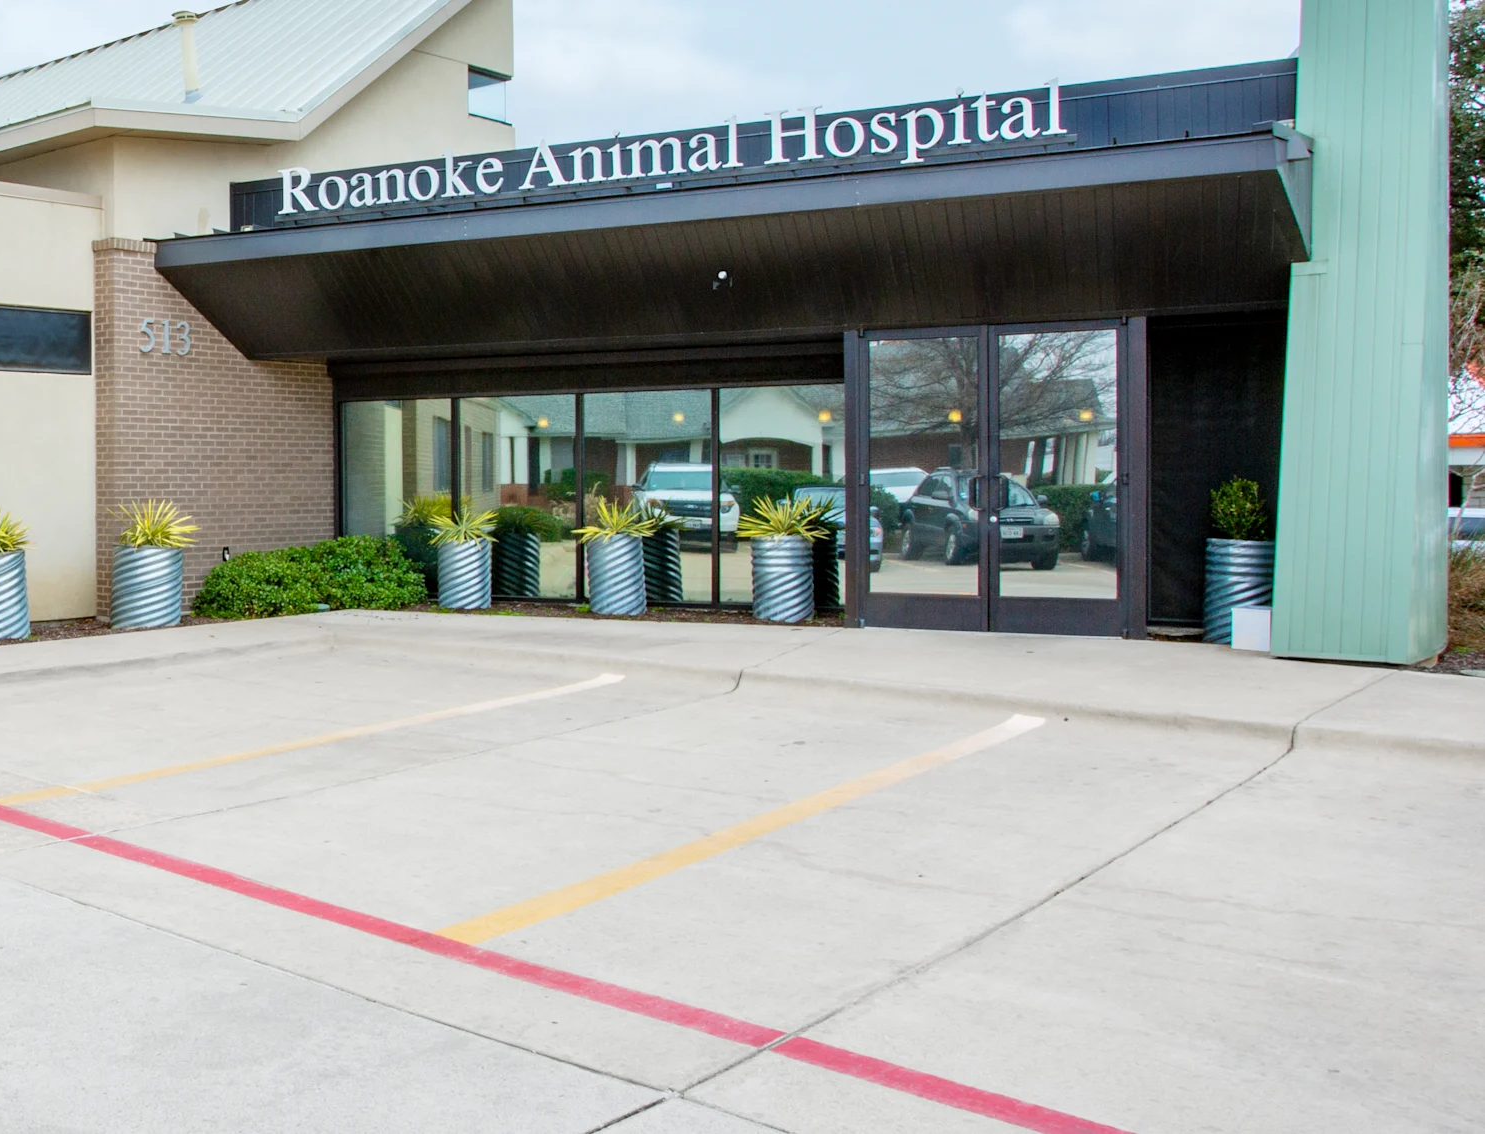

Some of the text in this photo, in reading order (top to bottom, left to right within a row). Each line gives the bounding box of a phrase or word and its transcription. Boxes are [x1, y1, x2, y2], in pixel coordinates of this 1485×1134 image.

[277, 77, 1068, 215] Roanoke Animal Hospital
[139, 318, 191, 356] 513
